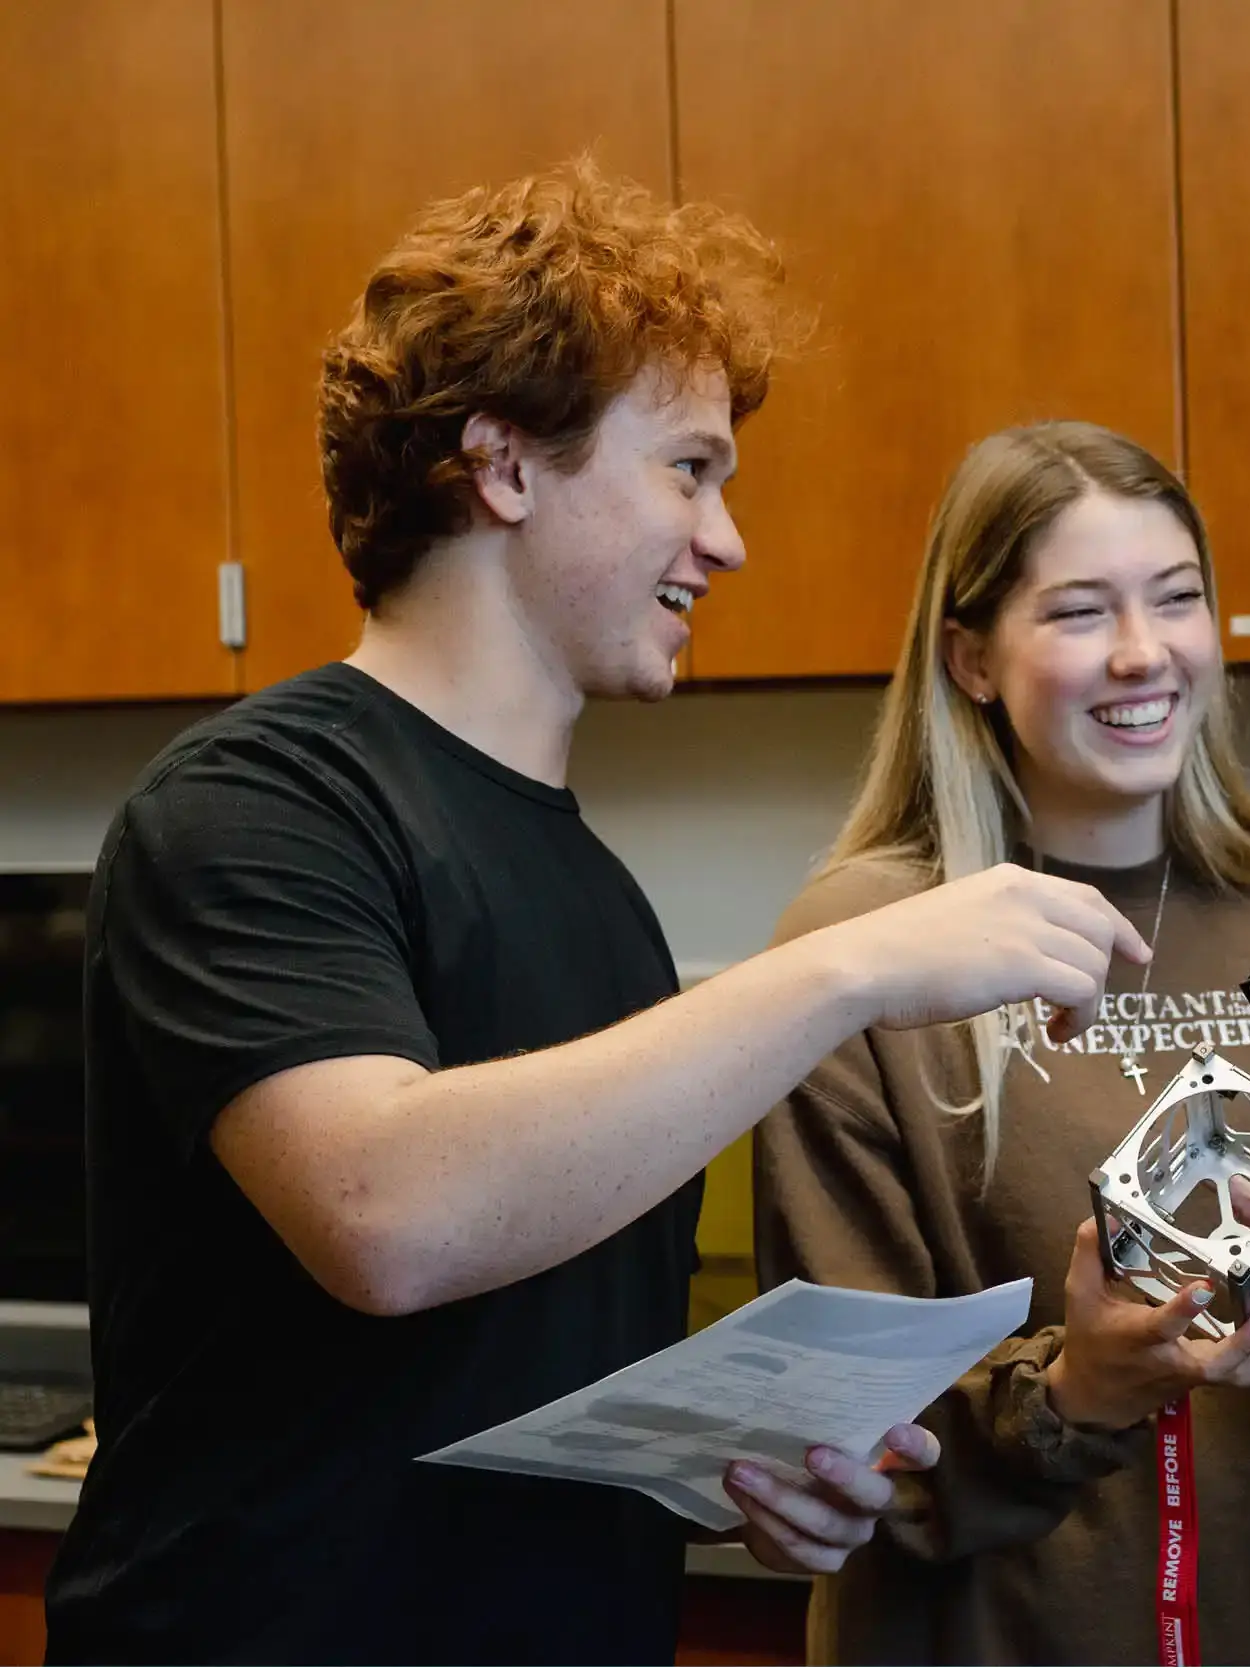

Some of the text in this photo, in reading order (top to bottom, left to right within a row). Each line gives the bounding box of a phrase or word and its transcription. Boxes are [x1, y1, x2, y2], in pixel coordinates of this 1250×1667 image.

[1033, 991, 1226, 1021] EECTANT
[1164, 1434, 1180, 1507] BEFORE
[1163, 1519, 1183, 1602] REMOVE
